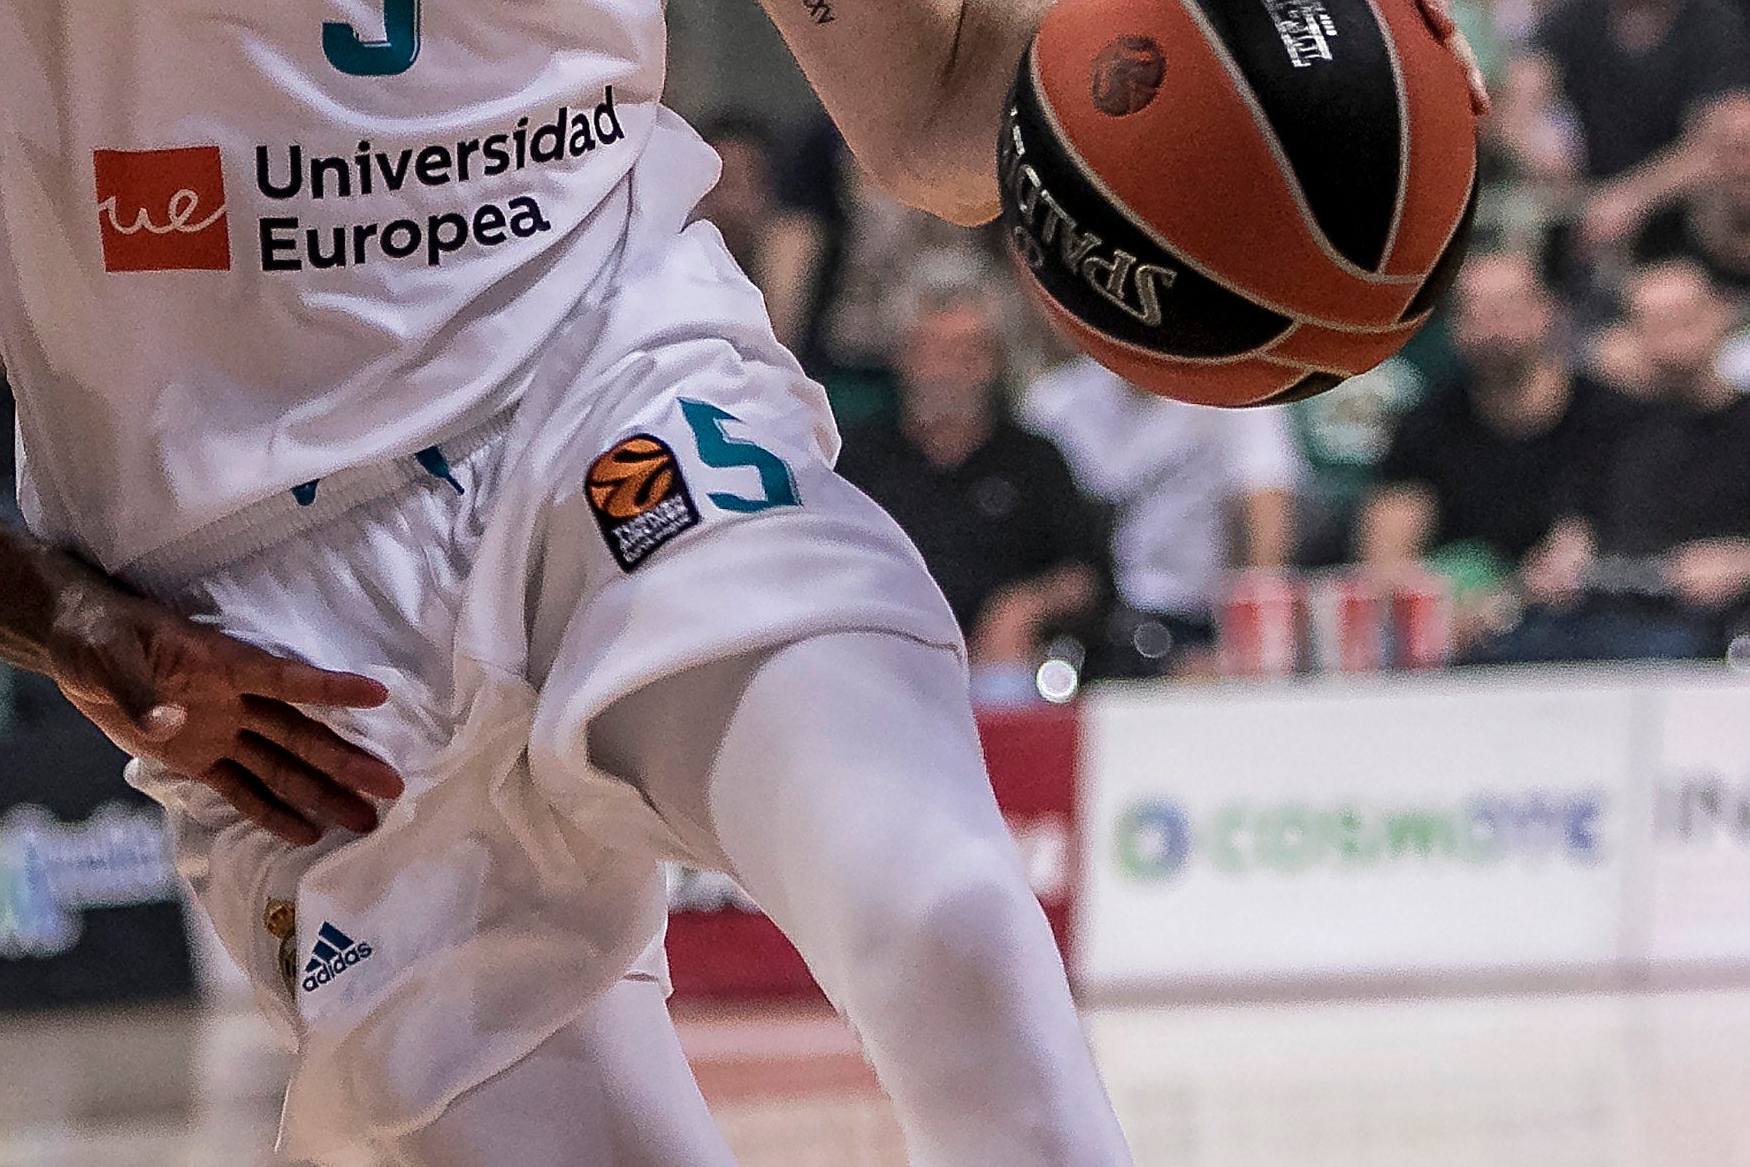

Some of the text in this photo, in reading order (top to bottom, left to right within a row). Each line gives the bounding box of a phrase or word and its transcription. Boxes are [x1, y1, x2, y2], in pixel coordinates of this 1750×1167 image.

[255, 85, 625, 199] Universidad
[258, 195, 551, 273] Europea
[1002, 104, 1178, 327] SPALD
[676, 396, 805, 514] 5
[302, 941, 373, 992] adidas
